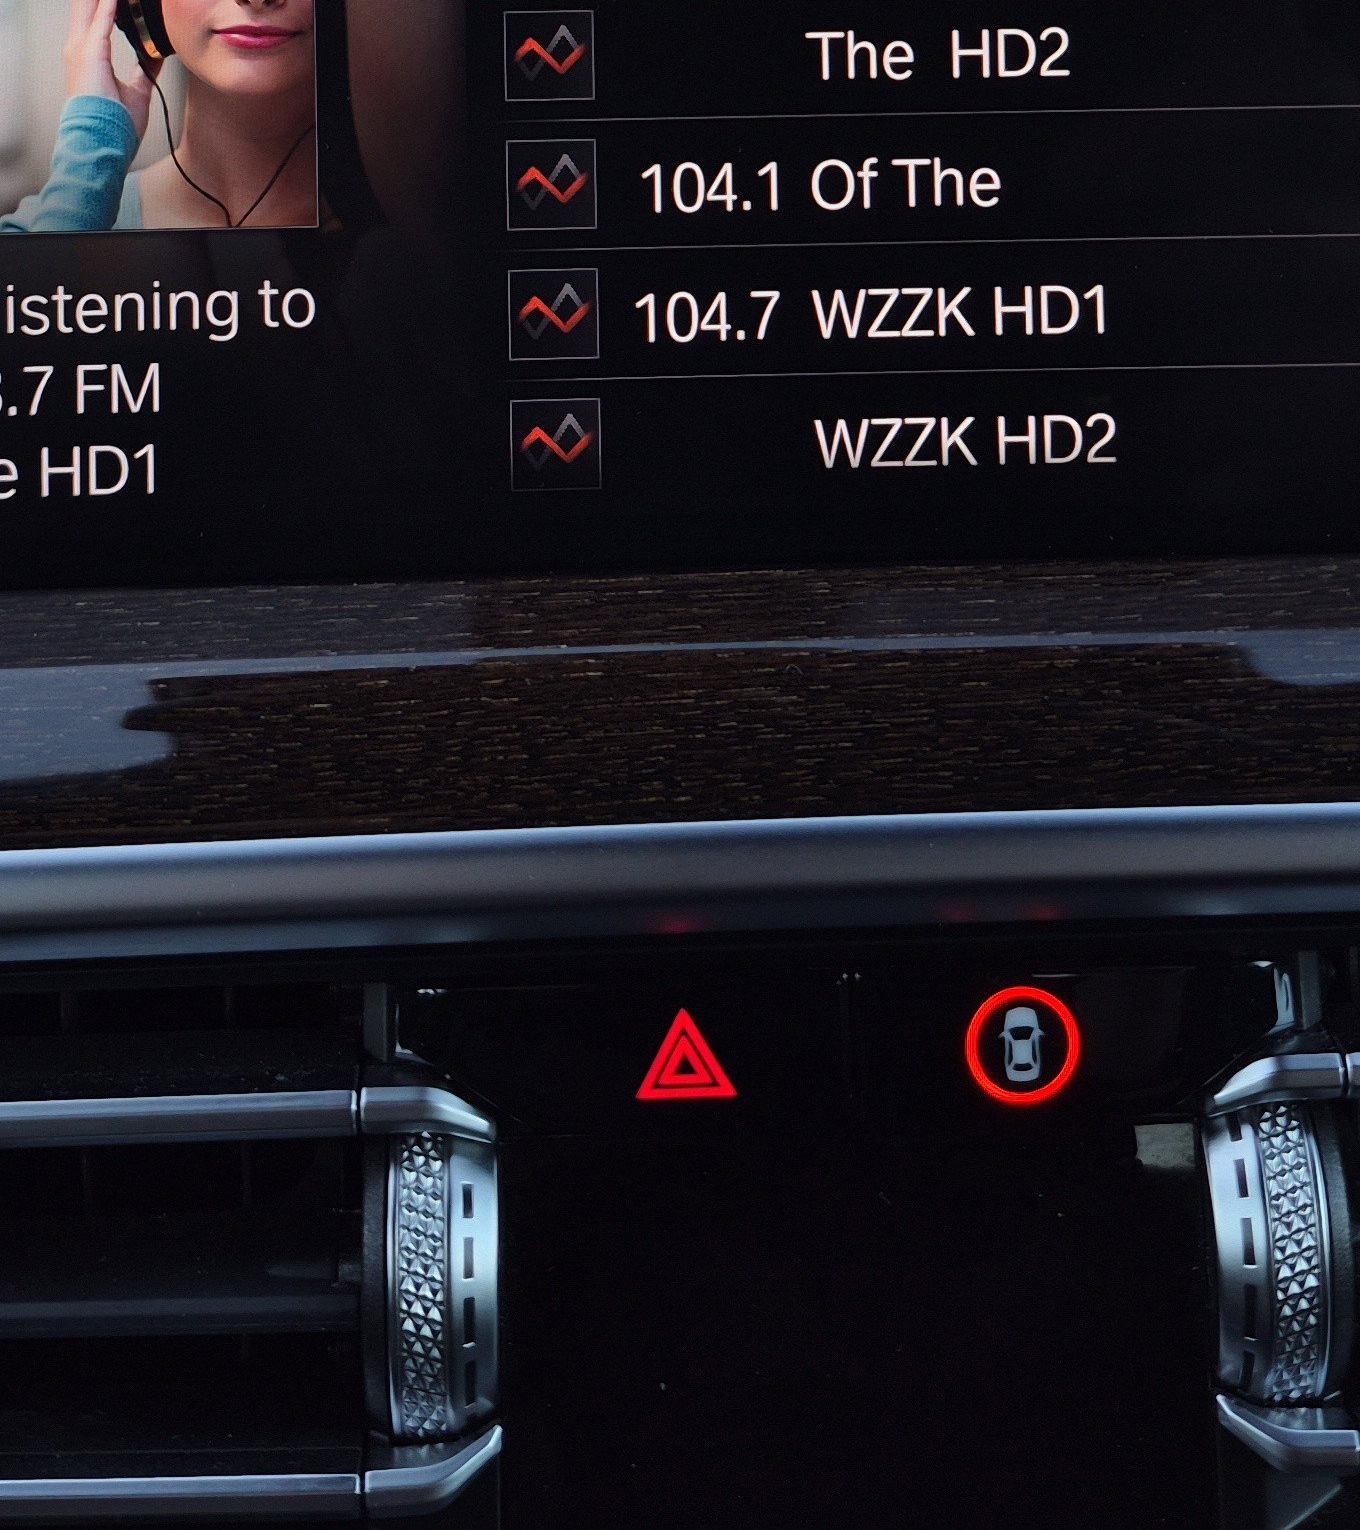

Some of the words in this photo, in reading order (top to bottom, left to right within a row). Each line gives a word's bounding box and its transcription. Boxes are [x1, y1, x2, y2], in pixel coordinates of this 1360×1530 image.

[804, 29, 915, 81] The
[951, 26, 1071, 79] HD2
[640, 161, 779, 214] 104.1
[811, 156, 879, 211] Of
[890, 156, 1002, 208] The
[257, 279, 316, 329] to
[634, 290, 781, 344] 104.7
[810, 286, 976, 340] WZZK
[994, 284, 1105, 336] HD1
[75, 362, 160, 415] FM
[813, 416, 978, 469] WZZK
[996, 412, 1117, 465] HD2
[40, 443, 155, 498] HD1
